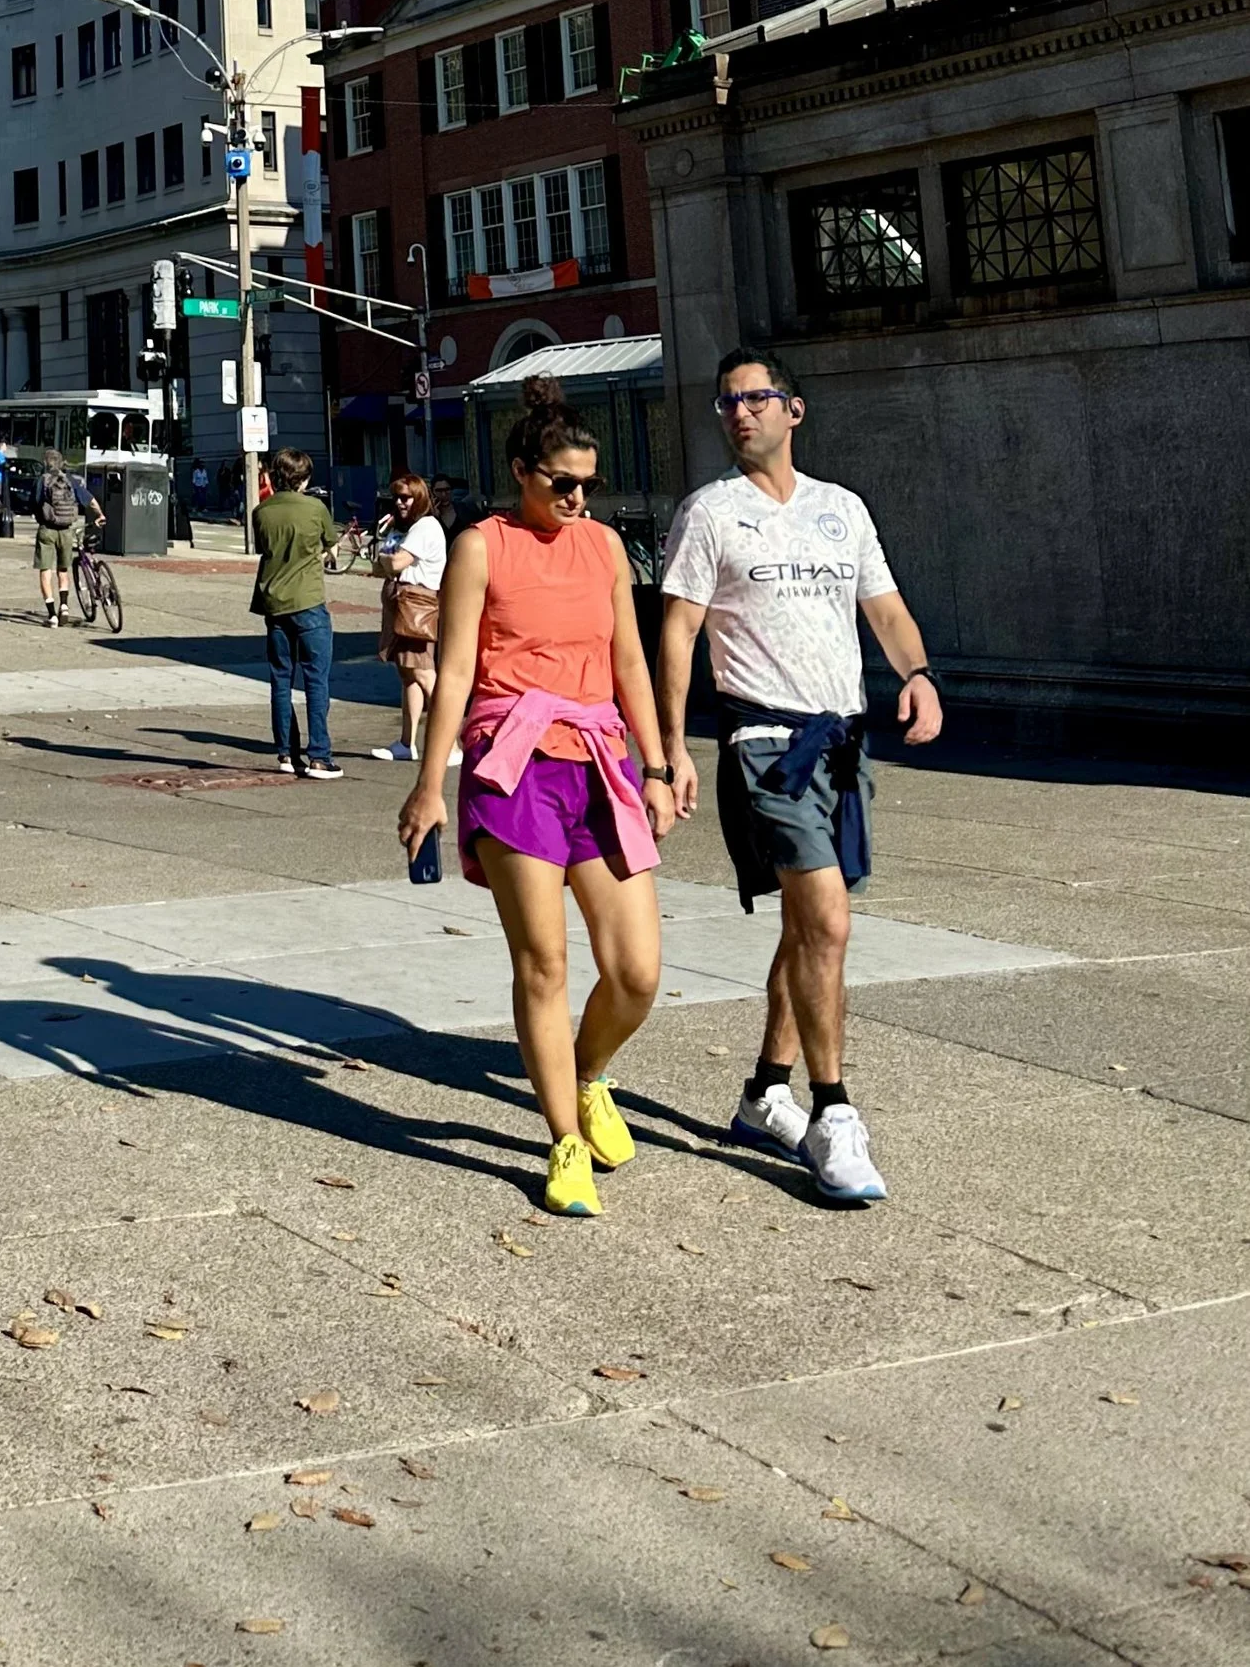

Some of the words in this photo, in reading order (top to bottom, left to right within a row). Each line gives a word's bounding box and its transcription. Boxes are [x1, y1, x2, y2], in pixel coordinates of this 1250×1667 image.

[199, 300, 219, 315] PARK
[748, 562, 855, 582] ETIHAD
[777, 585, 843, 599] AIRWAYS
